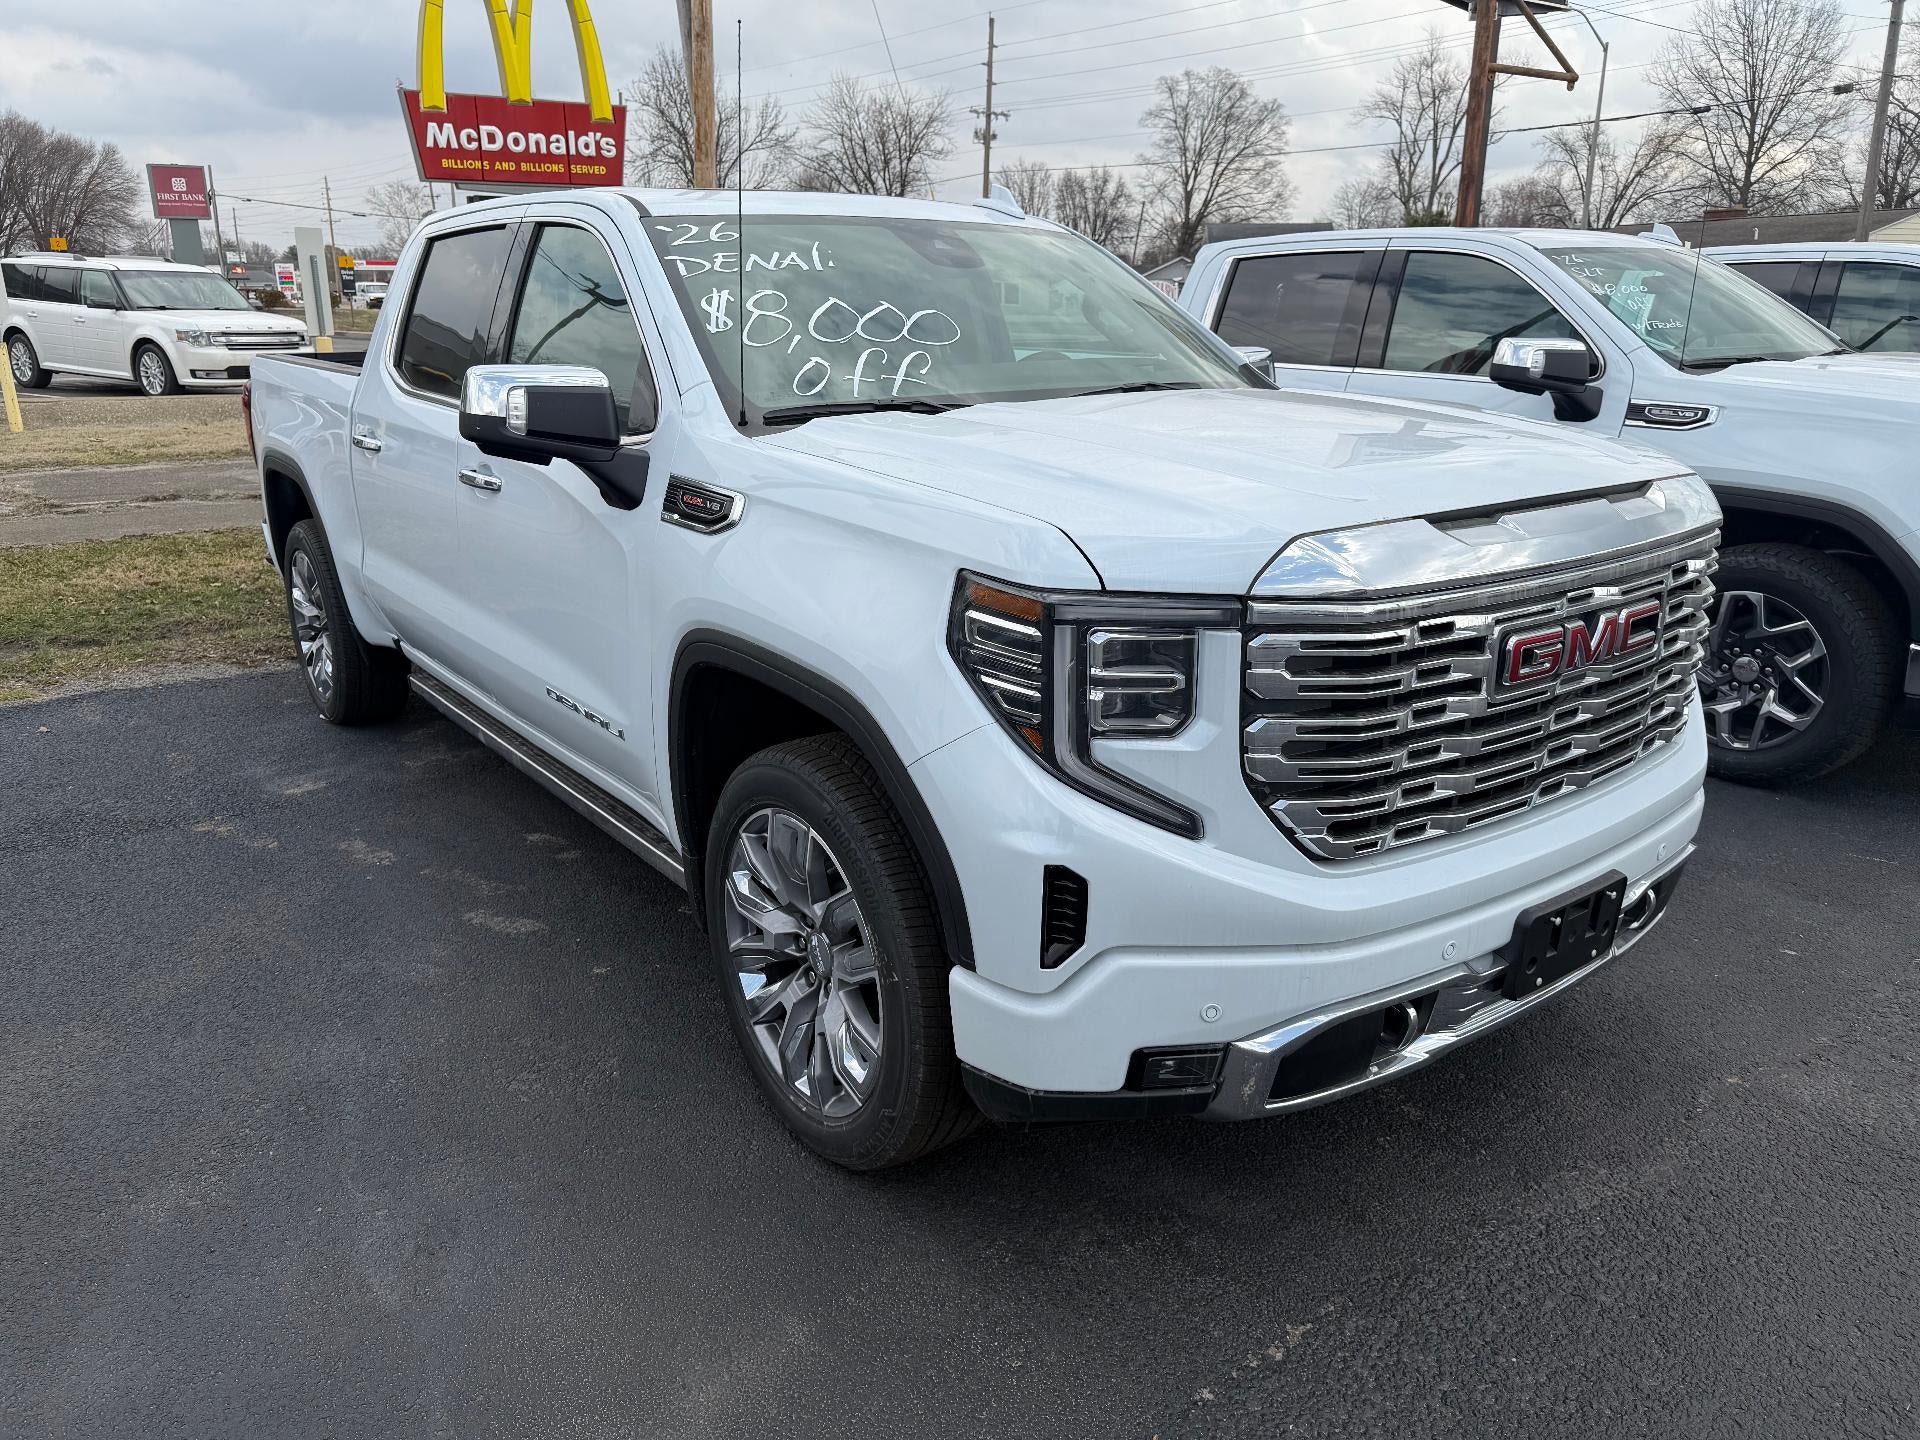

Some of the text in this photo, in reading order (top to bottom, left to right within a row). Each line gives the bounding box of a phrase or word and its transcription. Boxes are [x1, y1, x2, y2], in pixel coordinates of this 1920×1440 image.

[426, 121, 617, 158] McDonald's
[441, 158, 607, 175] BILLIONS AND BILLIONS SERVED
[157, 193, 206, 201] FIRST BANK
[1571, 266, 1606, 278] SLT
[706, 500, 721, 511] V8
[1502, 598, 1660, 686] GMC
[545, 685, 626, 742] DENALI
[822, 811, 882, 920] BRIDGESTON
